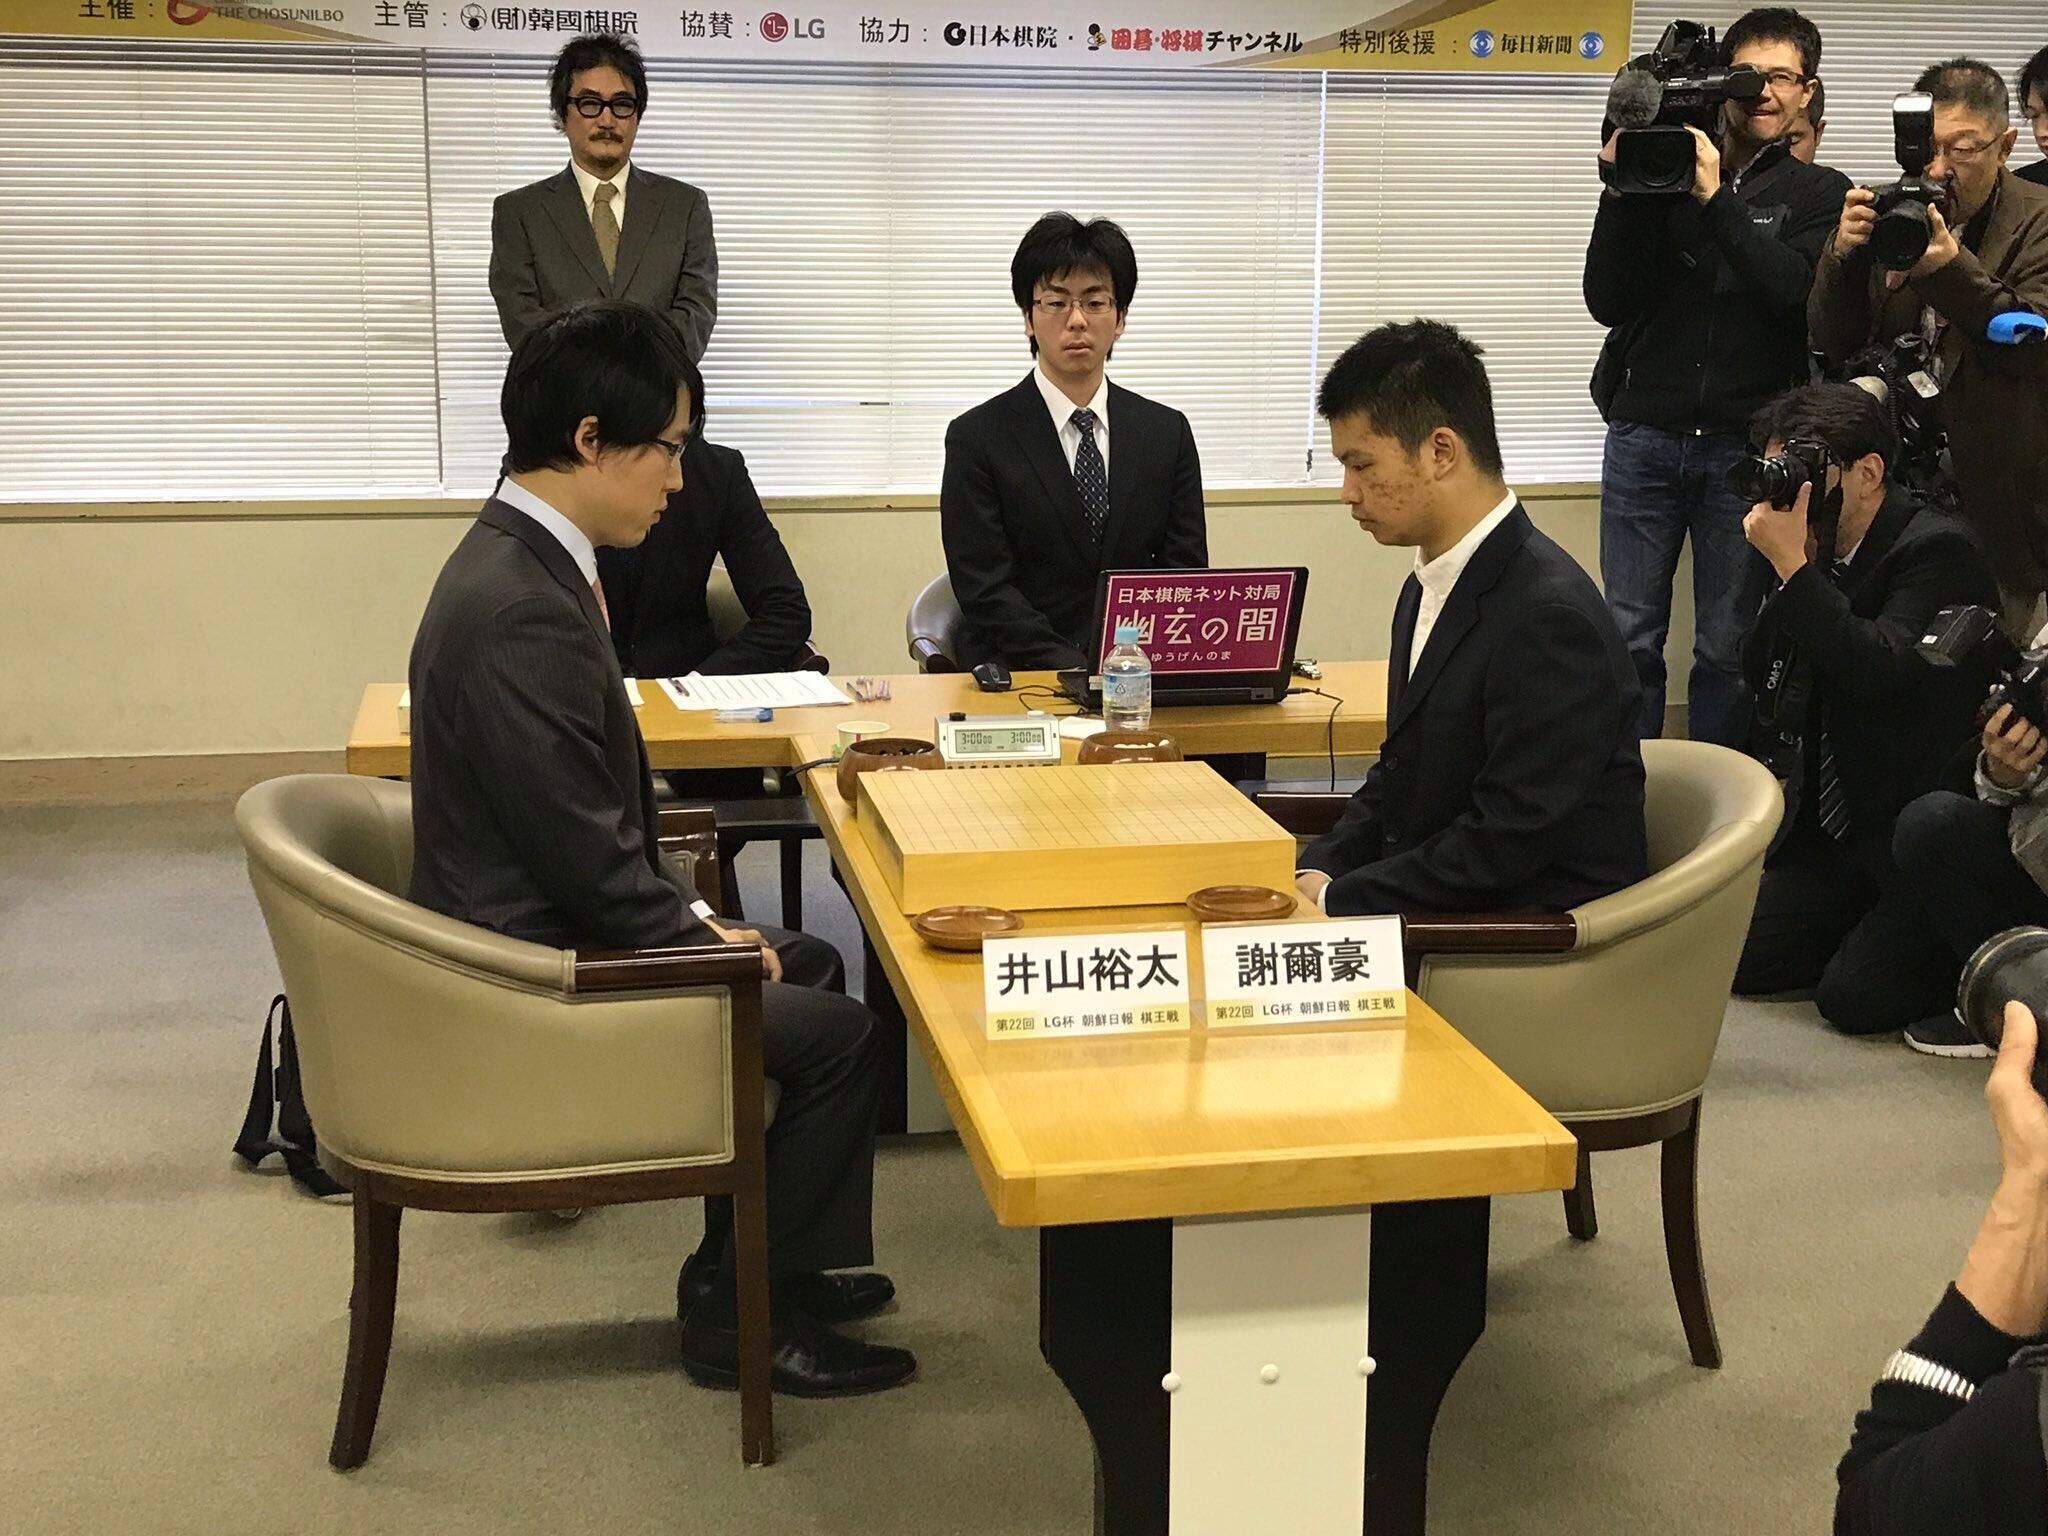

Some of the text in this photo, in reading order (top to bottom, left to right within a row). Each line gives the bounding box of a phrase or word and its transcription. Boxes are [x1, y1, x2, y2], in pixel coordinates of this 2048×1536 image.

[214, 7, 344, 21] THE CHOSUNILBO
[794, 18, 826, 39] LG
[1500, 33, 1572, 54] 毎日新聞
[1118, 584, 1281, 604] 日本棋院ネット対局
[1151, 651, 1232, 662] ゆうげんのま
[997, 944, 1180, 996] 井山裕太
[1235, 937, 1370, 988] 謝爾豪
[1216, 1005, 1254, 1020] 第22回
[1263, 1003, 1293, 1016] LG杯
[1300, 1000, 1351, 1014] 朝鮮日報
[996, 1018, 1035, 1032] 第22回
[1044, 1015, 1075, 1028] LG杯
[1082, 1012, 1133, 1027] 朝鮮日報
